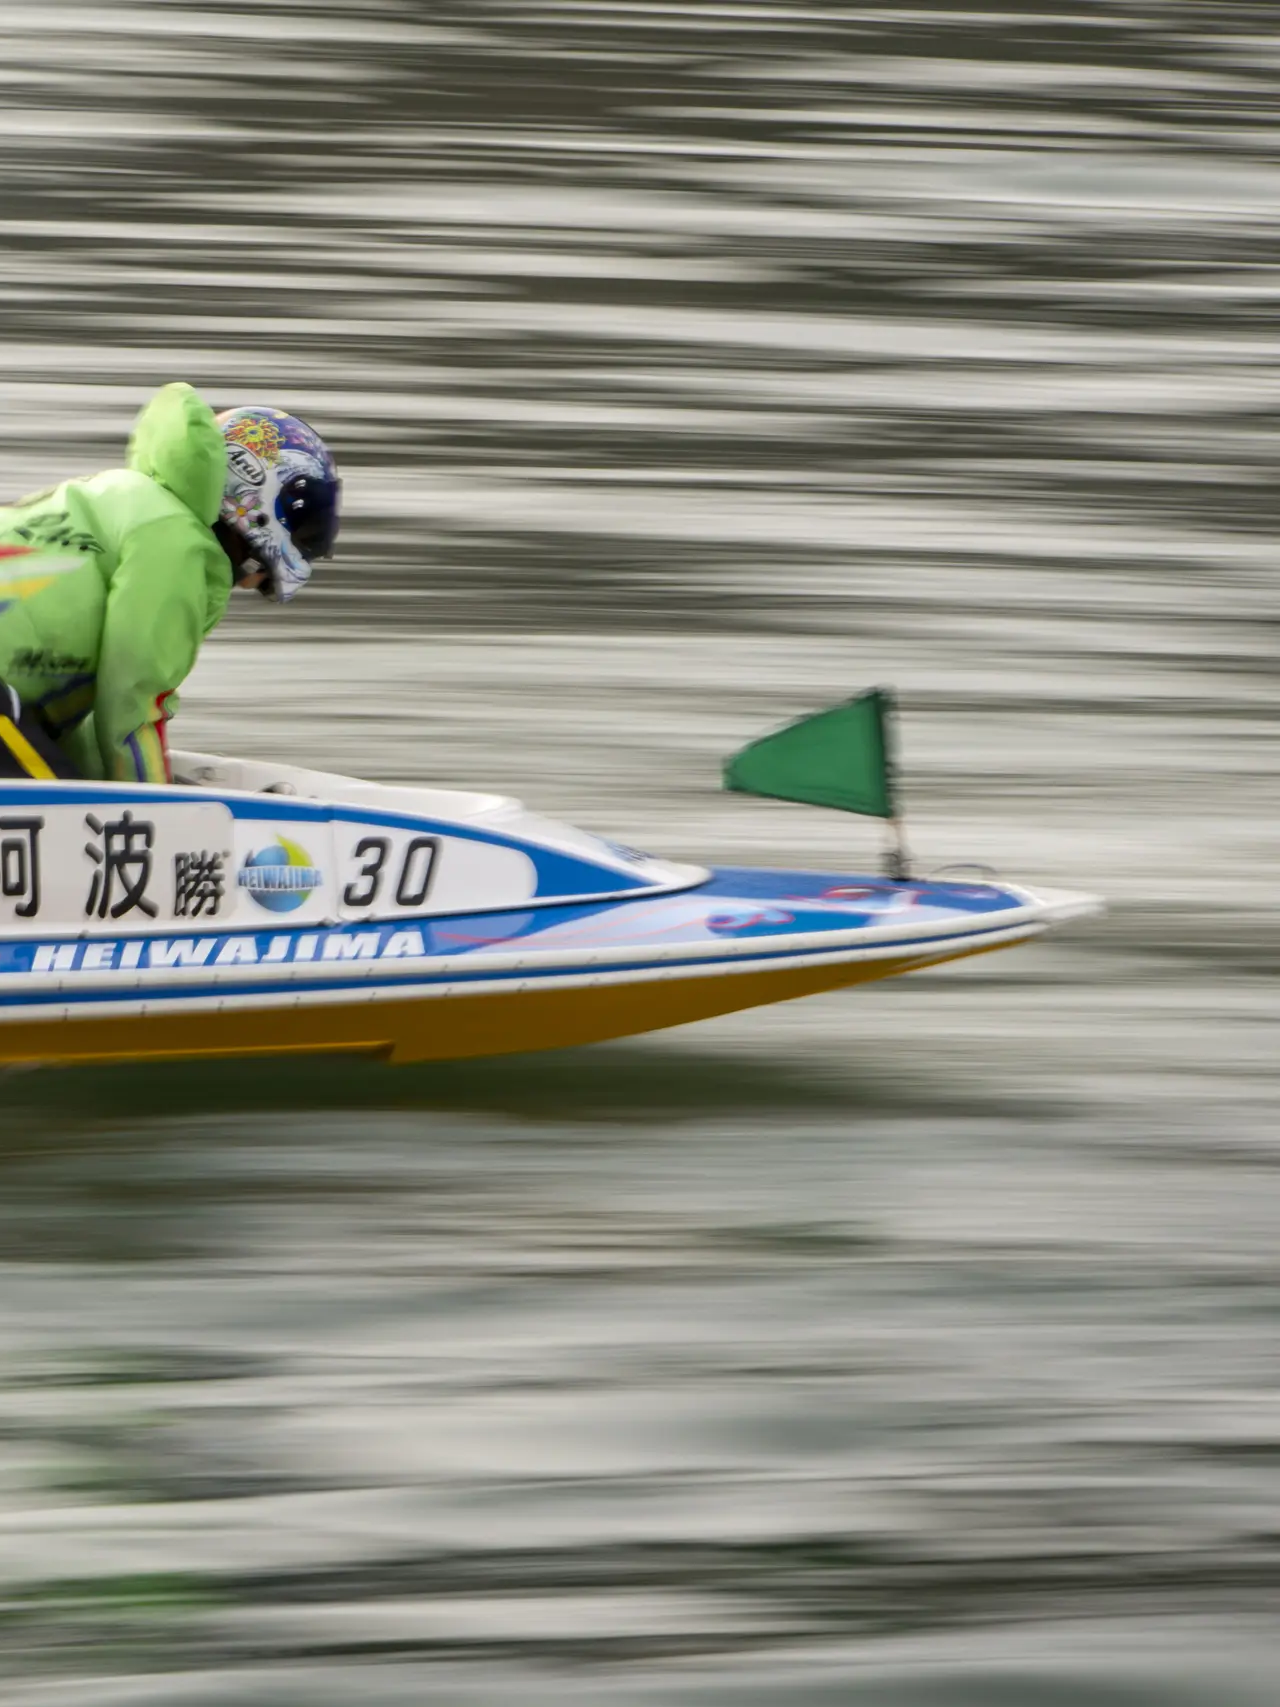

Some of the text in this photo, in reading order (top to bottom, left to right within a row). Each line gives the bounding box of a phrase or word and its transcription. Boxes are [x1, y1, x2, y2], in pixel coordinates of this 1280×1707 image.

[227, 450, 262, 480] Arai
[238, 866, 323, 890] HEIWAJIMA
[343, 837, 439, 907] 30
[31, 931, 425, 972] HEIWAJIMA
